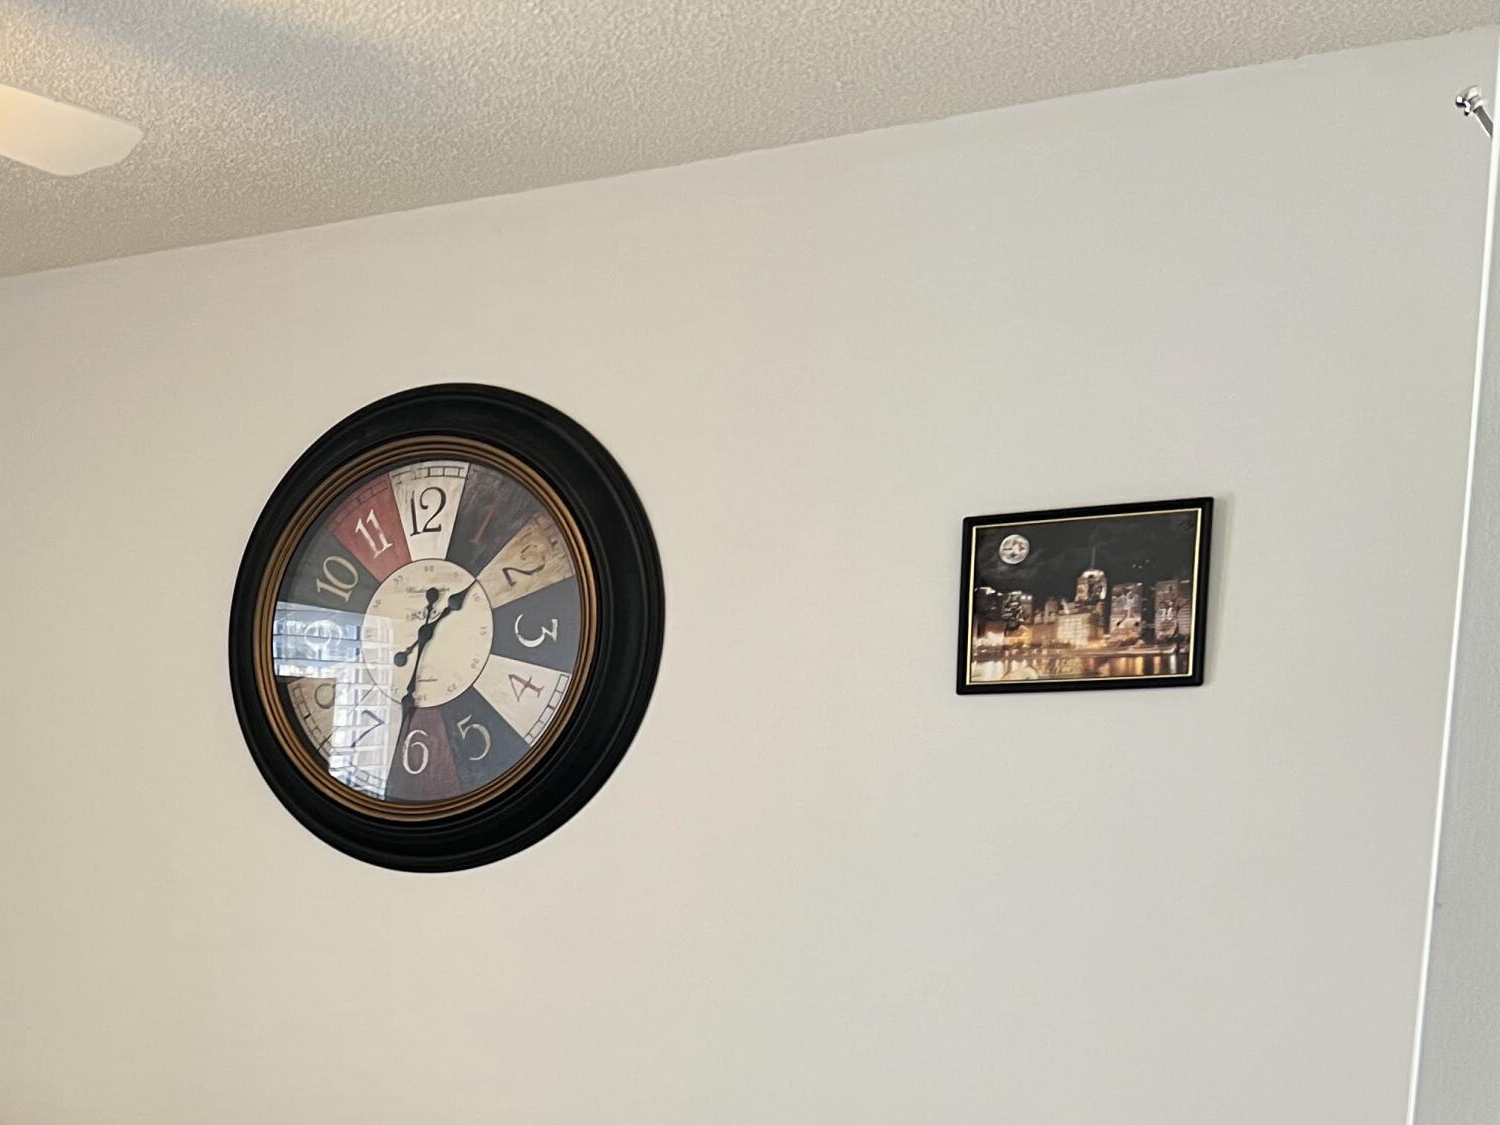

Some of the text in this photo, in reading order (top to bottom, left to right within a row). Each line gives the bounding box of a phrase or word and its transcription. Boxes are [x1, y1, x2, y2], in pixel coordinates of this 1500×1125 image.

[355, 508, 394, 560] 11
[410, 486, 448, 537] 12
[316, 556, 359, 602] 10
[501, 541, 547, 587] 2
[513, 614, 559, 648] 3
[507, 673, 546, 702] 4
[401, 729, 430, 775] 6
[455, 714, 493, 762] 5
